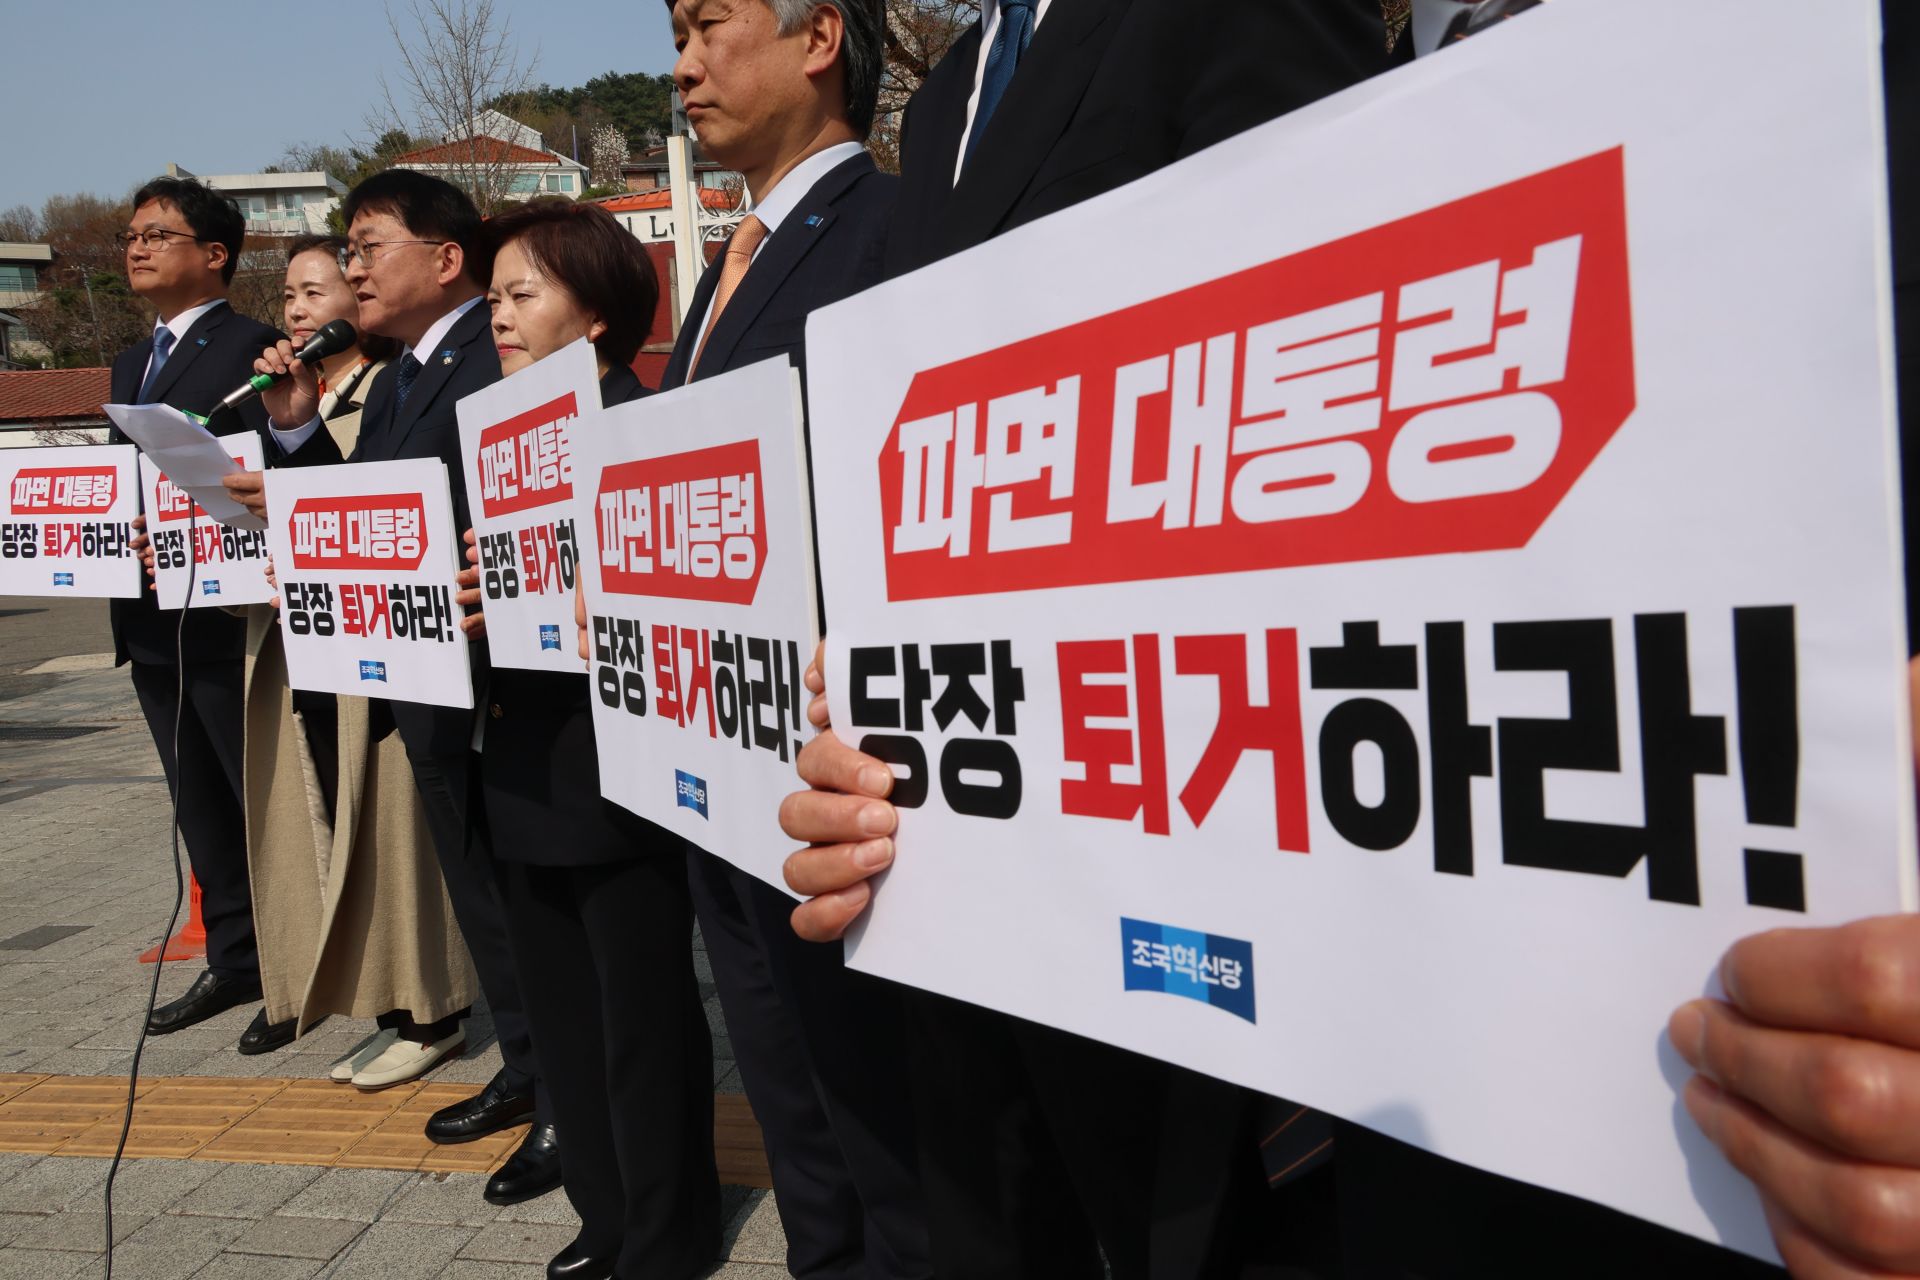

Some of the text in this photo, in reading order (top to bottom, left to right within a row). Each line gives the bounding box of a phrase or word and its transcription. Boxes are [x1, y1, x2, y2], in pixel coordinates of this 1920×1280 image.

[891, 233, 1583, 557] 파면 대통령
[13, 474, 114, 507] 파면 대통령
[481, 436, 518, 501] 파면
[2, 522, 131, 559] 당장 퇴거하라!
[153, 529, 186, 570] 당장
[293, 507, 421, 559] 파면 대통령
[600, 471, 756, 580] 파면 대통령
[479, 517, 580, 600] 당장 퇴거하
[284, 583, 454, 643] 당장 퇴거하라!
[592, 615, 804, 764] 당장 퇴거하라!
[848, 603, 1807, 914] 당장 퇴거하라!
[1132, 938, 1243, 990] 조국혁신당
